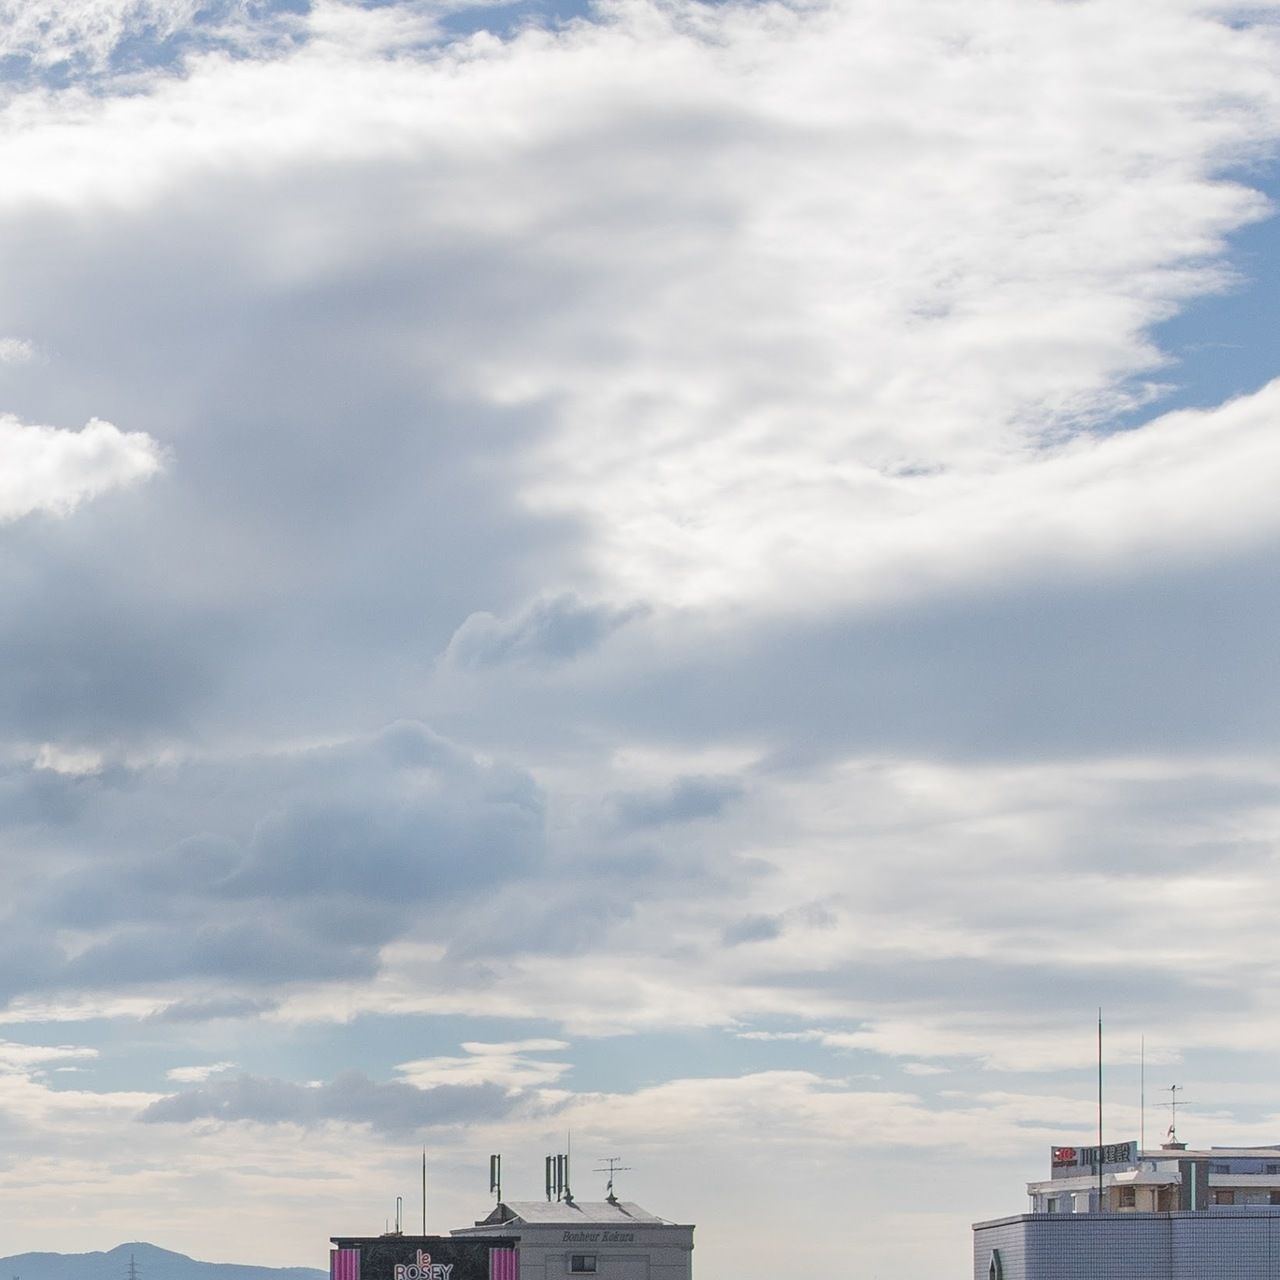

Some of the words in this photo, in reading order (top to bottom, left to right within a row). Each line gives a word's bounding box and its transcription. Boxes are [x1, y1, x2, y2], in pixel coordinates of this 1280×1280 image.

[562, 1231, 600, 1242] Bonheur
[601, 1231, 635, 1242] Kokura
[416, 1249, 431, 1266] le
[394, 1264, 454, 1280] ROSEY
